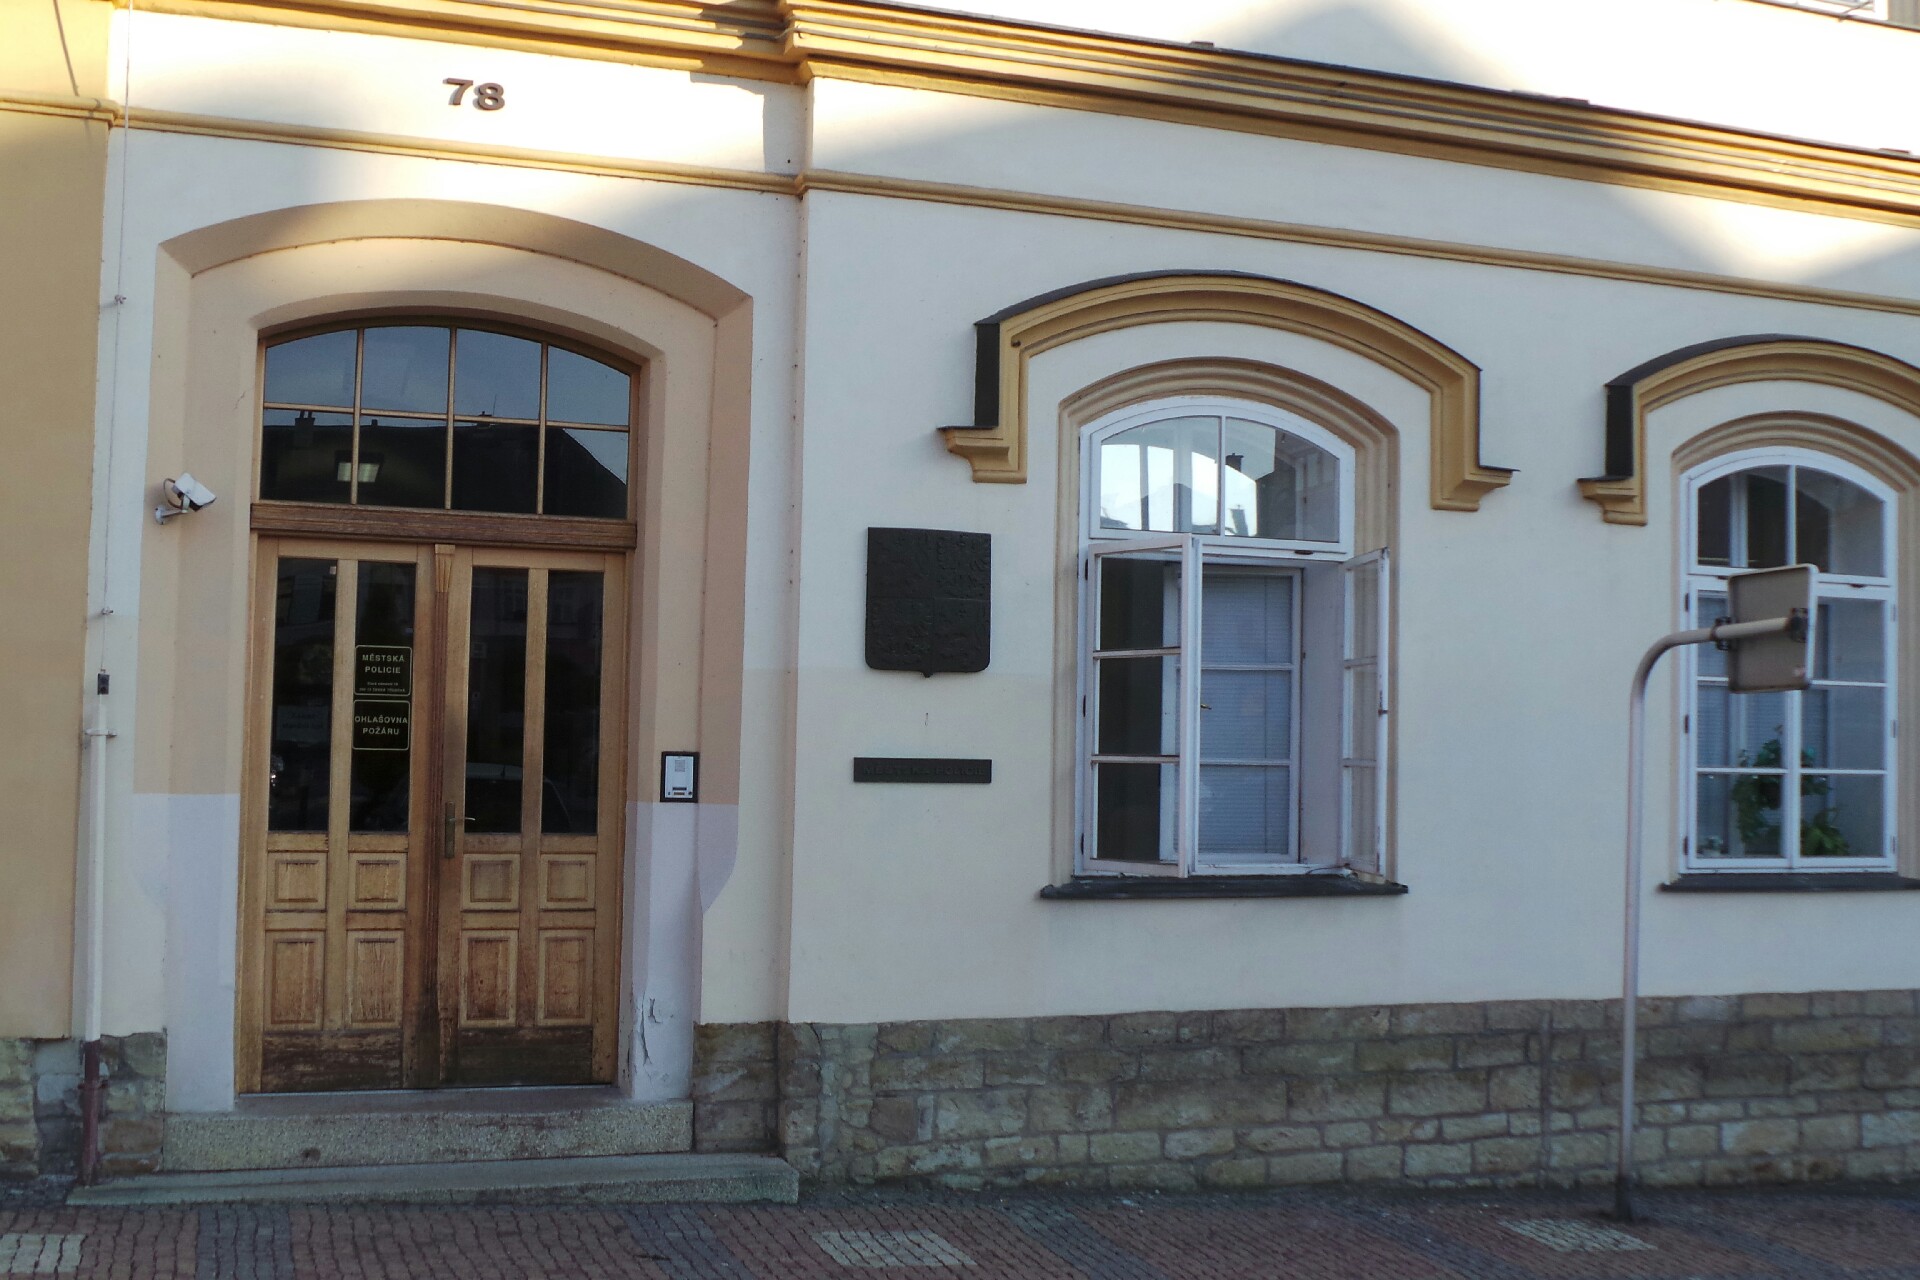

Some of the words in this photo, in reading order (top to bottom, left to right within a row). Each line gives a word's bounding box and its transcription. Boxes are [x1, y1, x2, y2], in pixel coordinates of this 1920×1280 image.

[445, 77, 505, 111] 78
[362, 653, 405, 662] MĚSTSKÁ
[365, 666, 401, 674] POLICIE
[354, 714, 408, 724] OHLAŠOVNA
[362, 726, 400, 735] POŽÁRU
